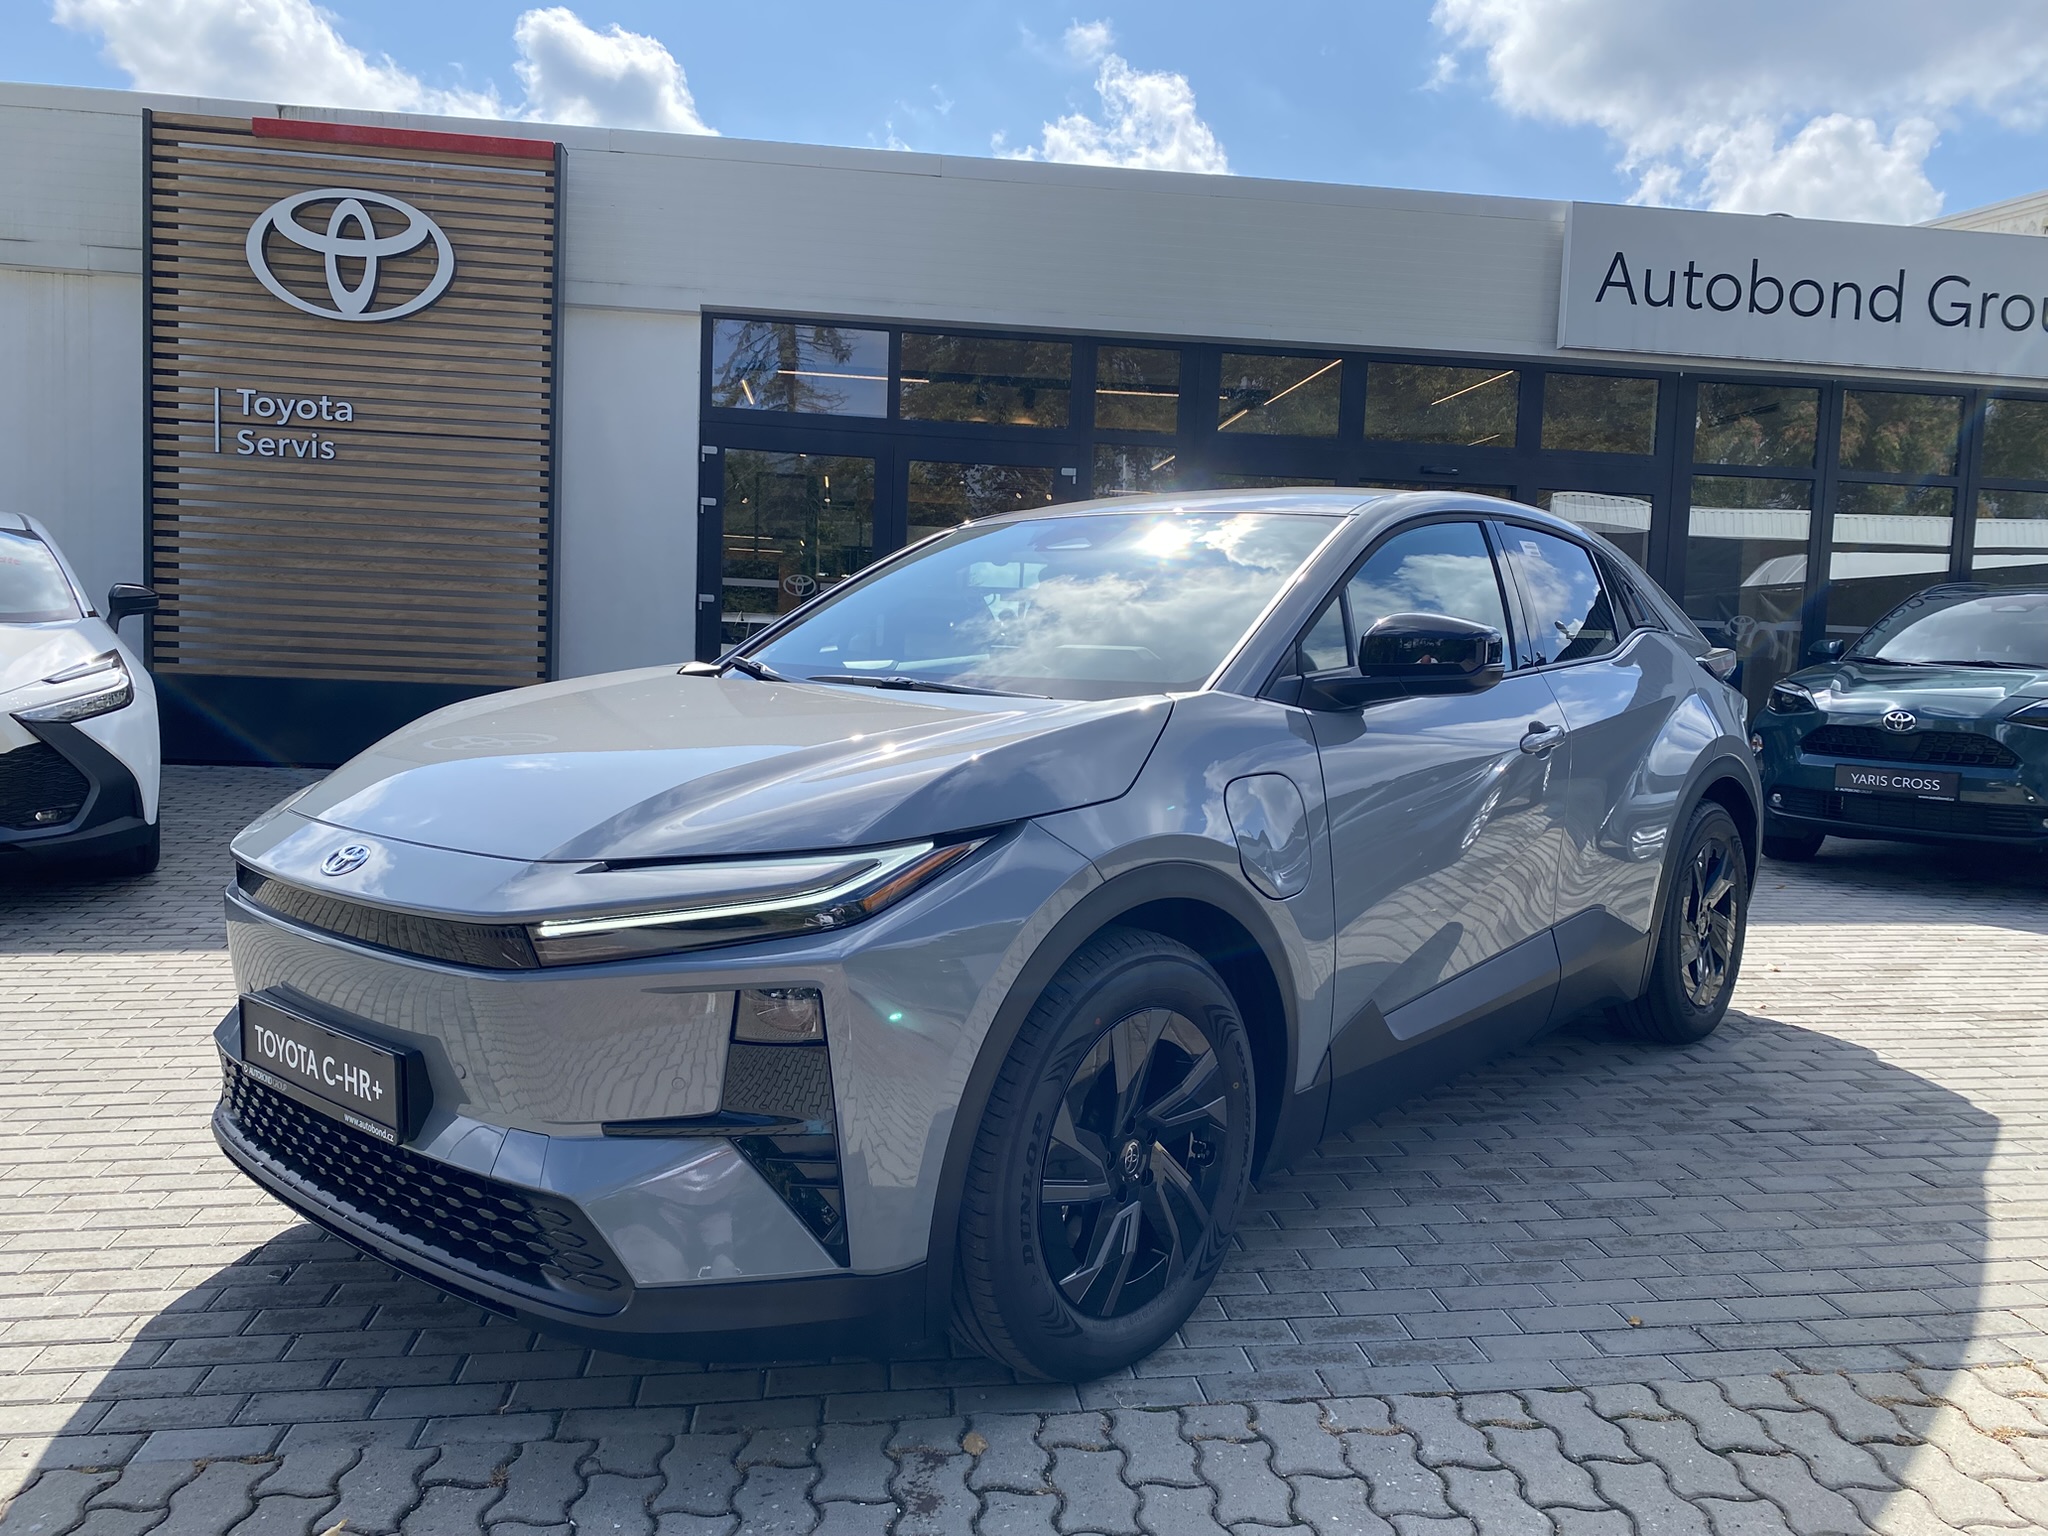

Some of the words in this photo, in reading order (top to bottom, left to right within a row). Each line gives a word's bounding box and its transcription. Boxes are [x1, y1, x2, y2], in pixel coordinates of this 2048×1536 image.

[1595, 251, 1906, 324] Autobond
[1927, 274, 2048, 332] Gro
[236, 388, 354, 425] Toyota
[236, 429, 336, 460] Servis
[1850, 772, 1888, 787] YARIS
[1891, 776, 1941, 791] CROSS
[254, 1024, 319, 1080] TOYOTA
[322, 1056, 383, 1102] C-HR+
[343, 1113, 395, 1143] www.autobond.cz
[1020, 1111, 1043, 1266] DUNLOP
